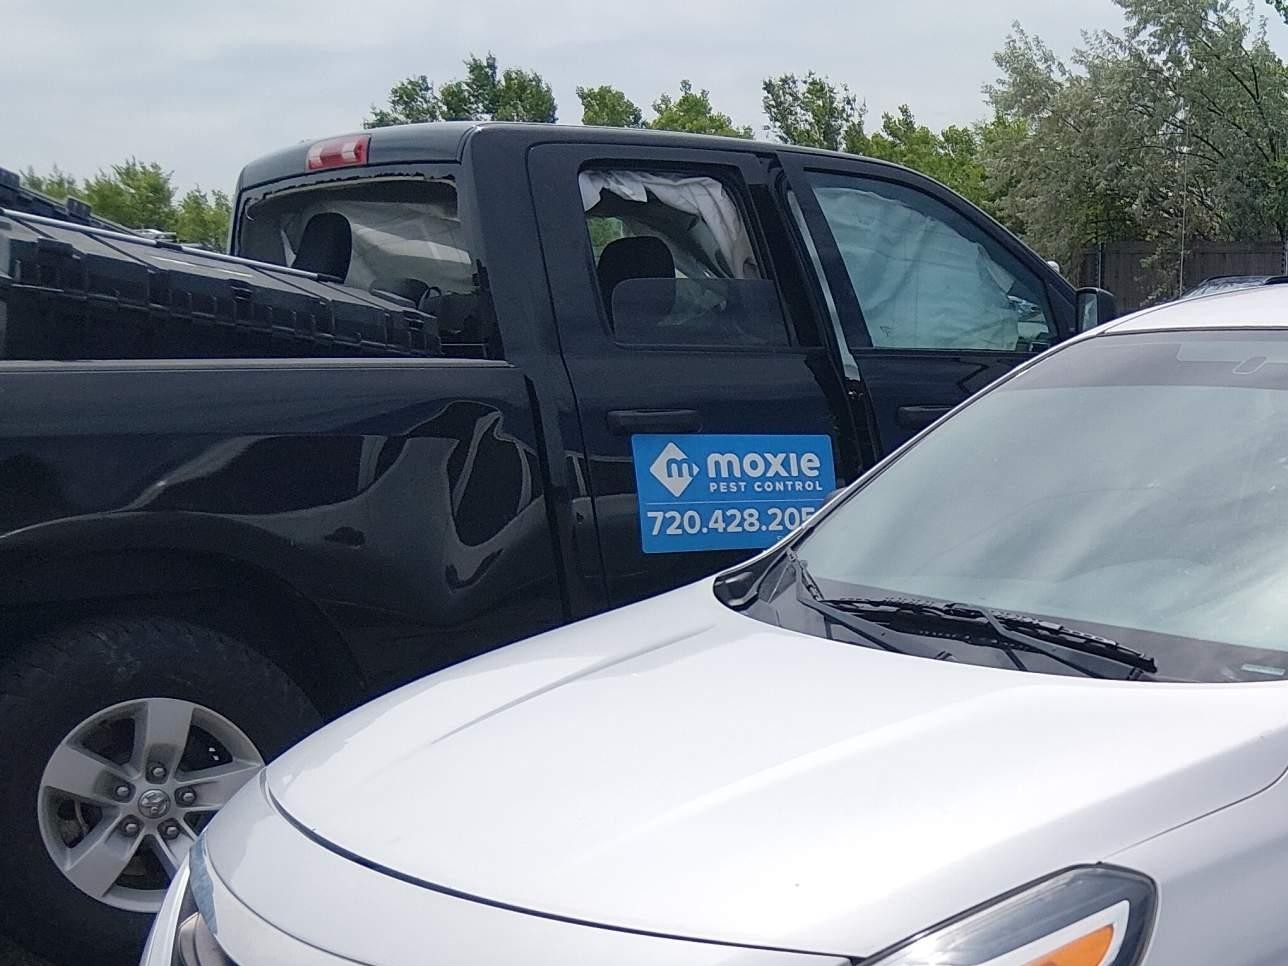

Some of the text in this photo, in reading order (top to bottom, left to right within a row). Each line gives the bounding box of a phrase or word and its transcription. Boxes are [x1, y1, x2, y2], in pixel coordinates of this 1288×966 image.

[707, 452, 821, 478] moxie
[709, 480, 823, 493] PEST CONTROL
